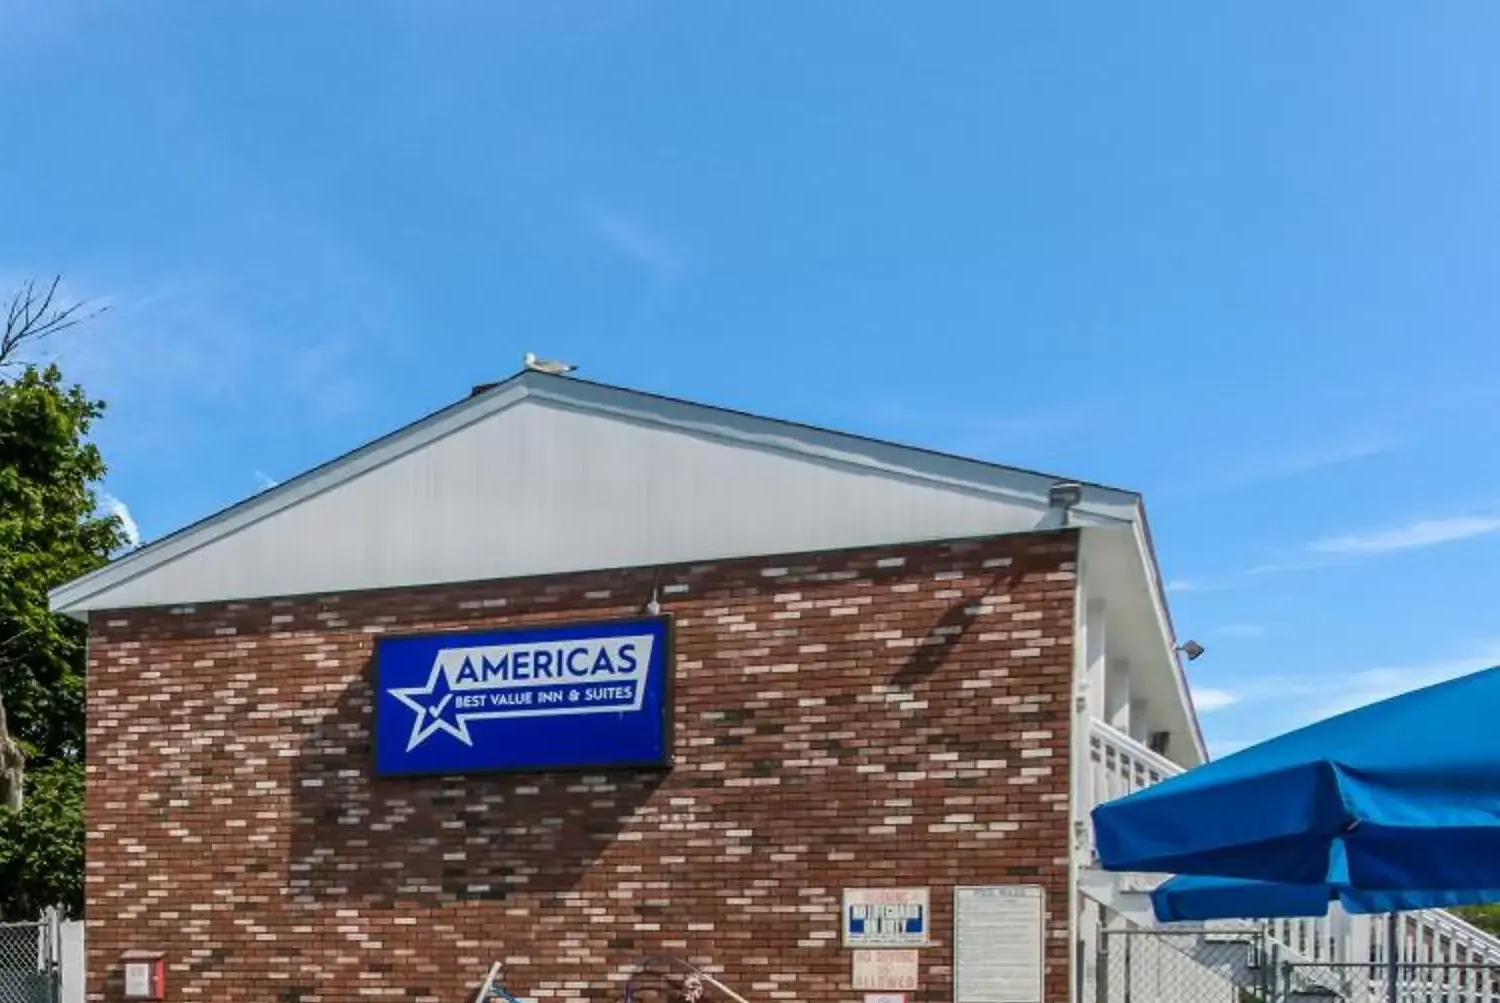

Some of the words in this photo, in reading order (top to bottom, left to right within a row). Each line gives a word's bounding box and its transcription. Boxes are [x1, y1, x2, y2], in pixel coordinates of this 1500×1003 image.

[456, 644, 637, 684] AMERICAS
[455, 694, 487, 708] BEST
[490, 691, 533, 706] VALUE
[538, 690, 563, 704] INN
[568, 688, 581, 702] &
[585, 685, 633, 701] SUITES
